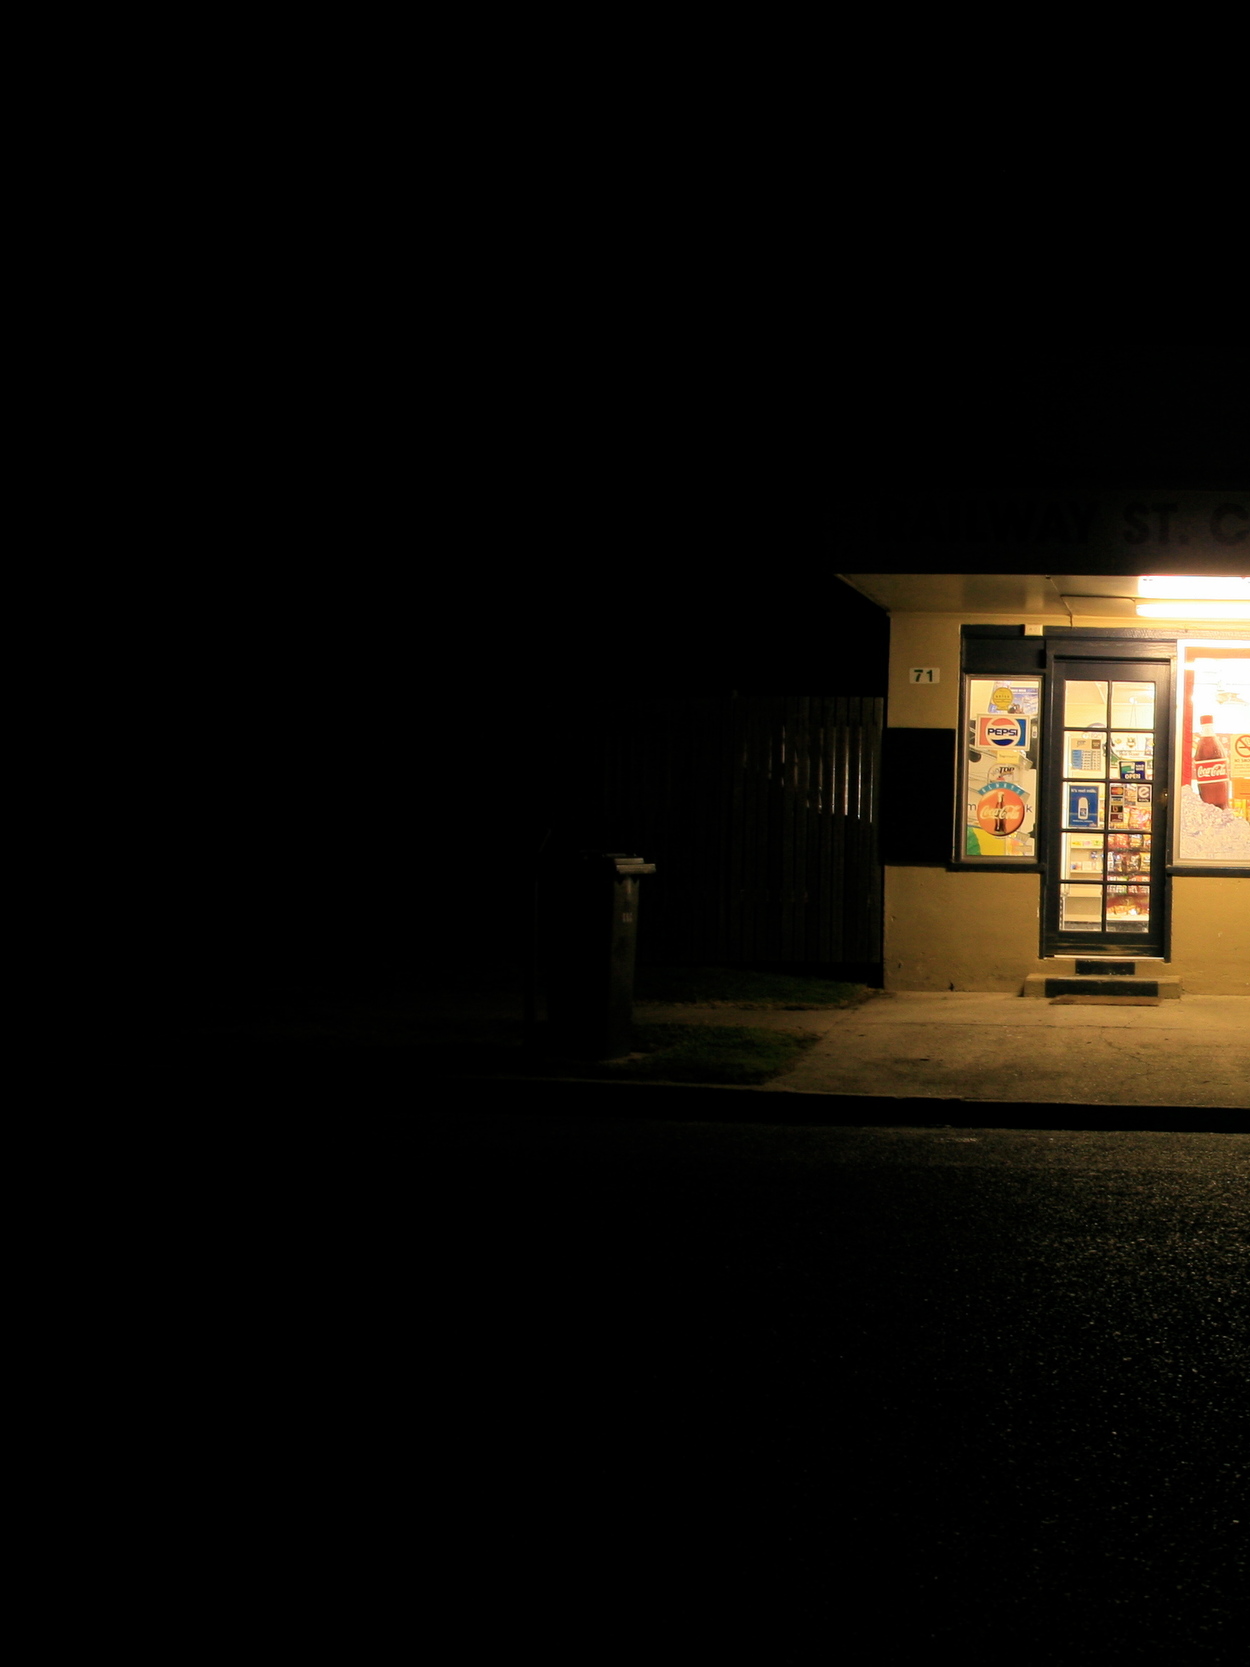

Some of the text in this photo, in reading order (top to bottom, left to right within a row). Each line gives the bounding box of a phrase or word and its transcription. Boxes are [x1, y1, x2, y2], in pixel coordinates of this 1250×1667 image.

[877, 498, 1099, 543] RAILWAY
[1122, 502, 1188, 546] ST.
[913, 669, 934, 682] 71
[987, 727, 1018, 737] PEPSI
[1198, 763, 1227, 778] Coca-Cola
[979, 804, 1021, 820] Coca-Cola
